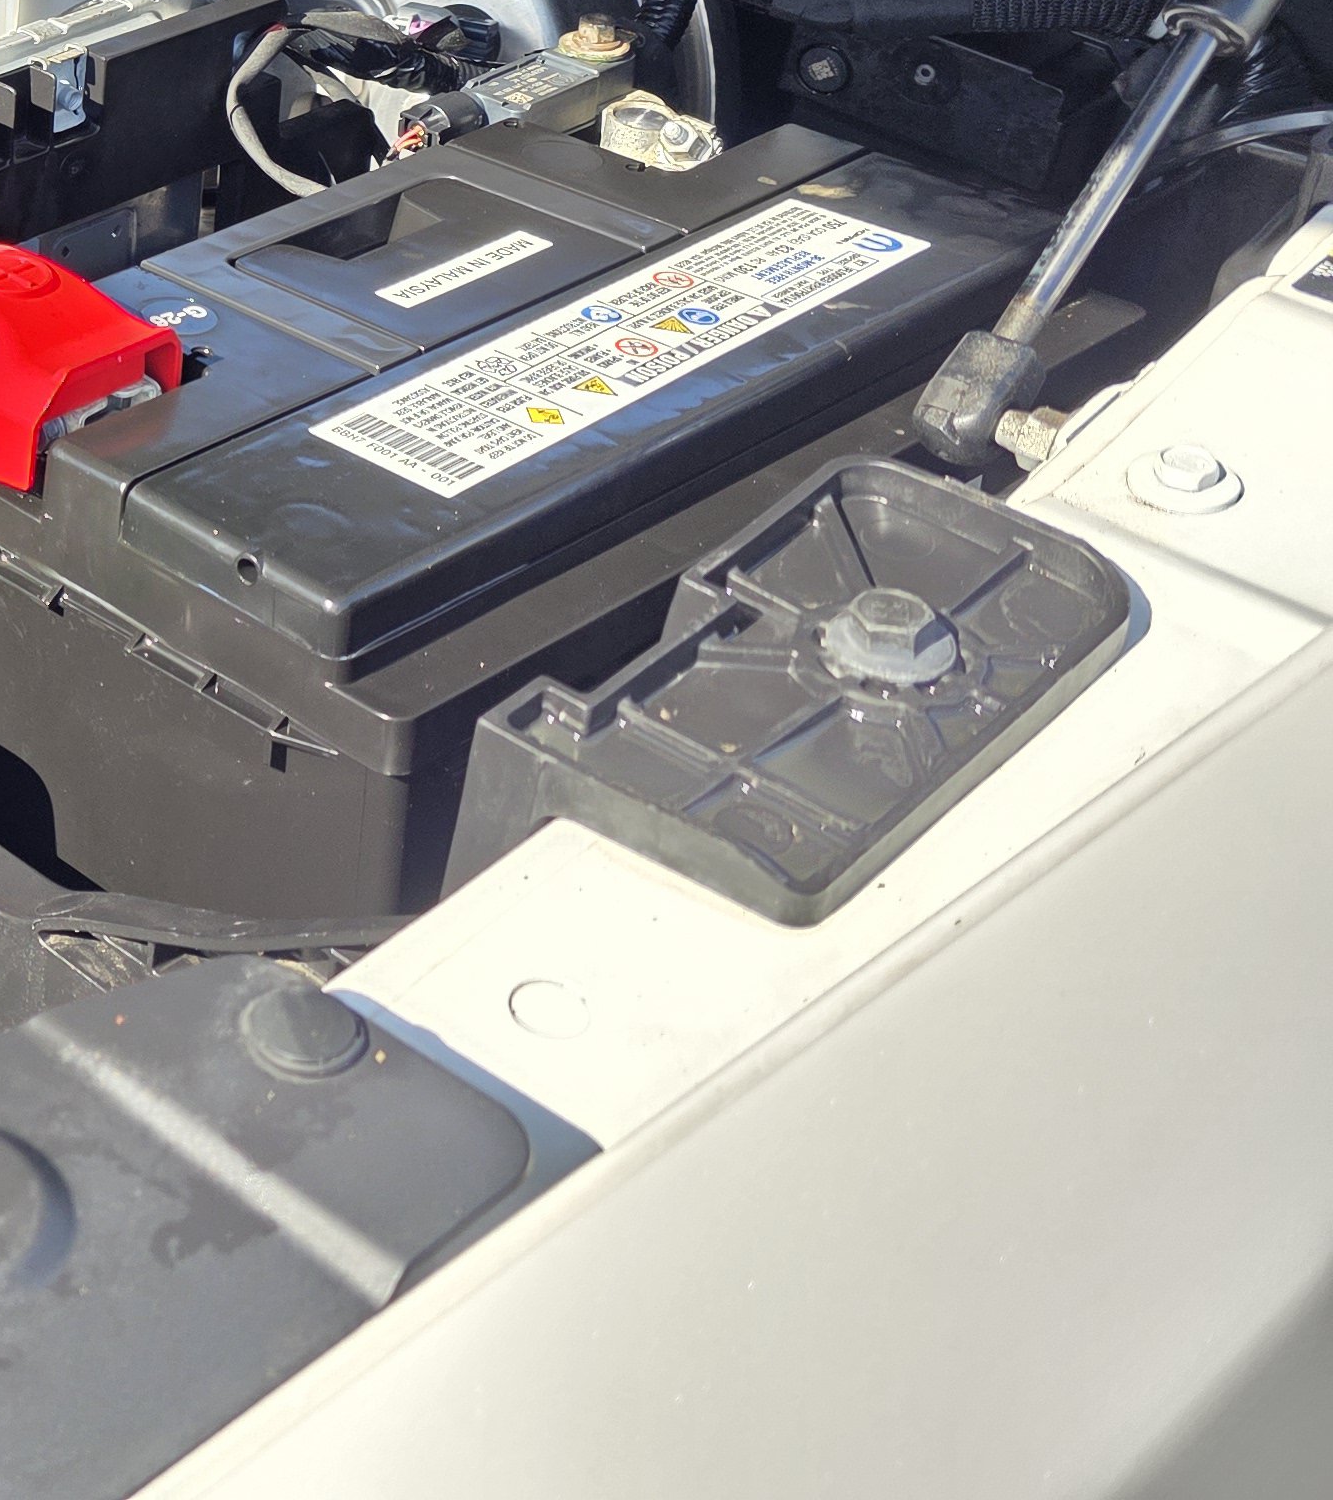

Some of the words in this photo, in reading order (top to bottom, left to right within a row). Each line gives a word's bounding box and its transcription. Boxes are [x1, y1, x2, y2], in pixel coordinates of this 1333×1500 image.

[467, 257, 491, 269] IN
[485, 238, 534, 261] MADE
[392, 265, 474, 299] MALAYSIA
[690, 314, 758, 349] DANGER
[625, 350, 691, 384] POISON
[398, 457, 418, 469] AA
[430, 472, 456, 487] 001
